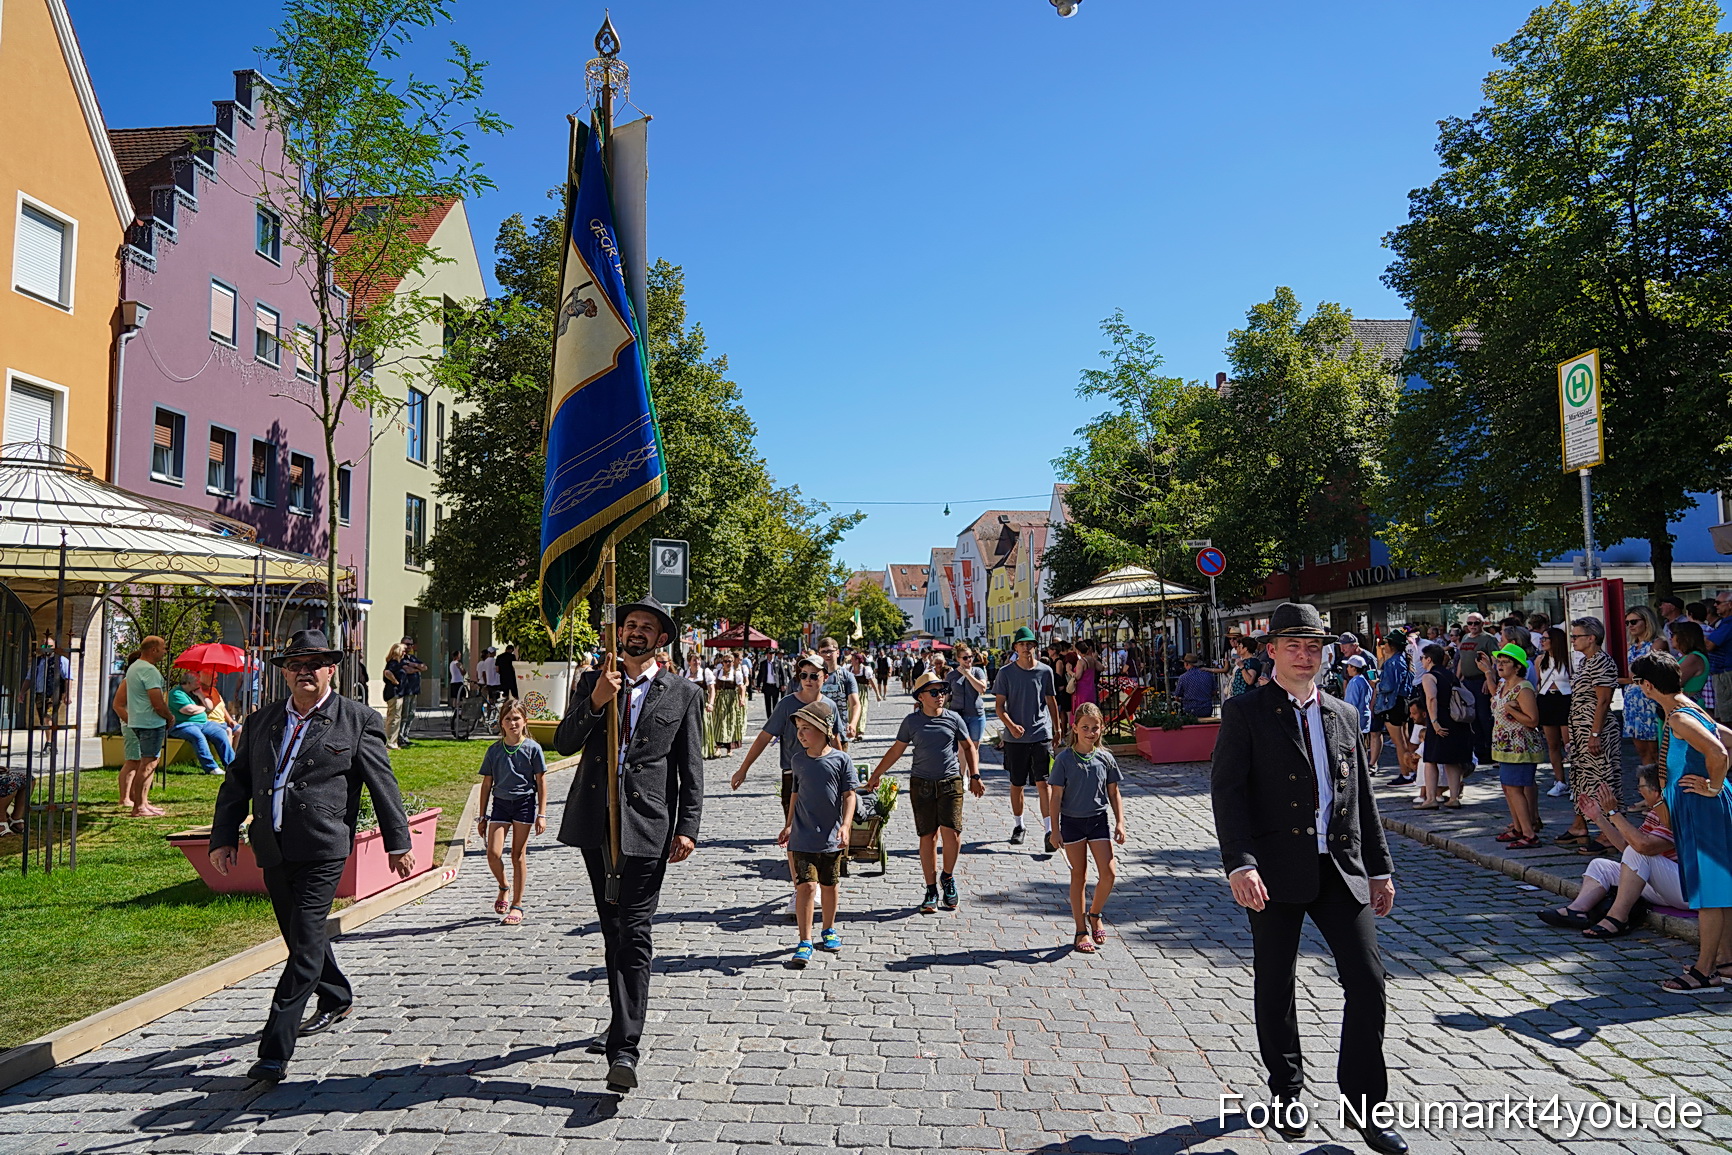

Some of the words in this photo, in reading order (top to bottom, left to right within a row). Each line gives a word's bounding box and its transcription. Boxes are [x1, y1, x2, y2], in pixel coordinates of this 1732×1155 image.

[1571, 371, 1588, 400] H
[1568, 408, 1593, 421] Marktplatz
[963, 576, 973, 599] SALE
[1347, 564, 1396, 588] ANTON
